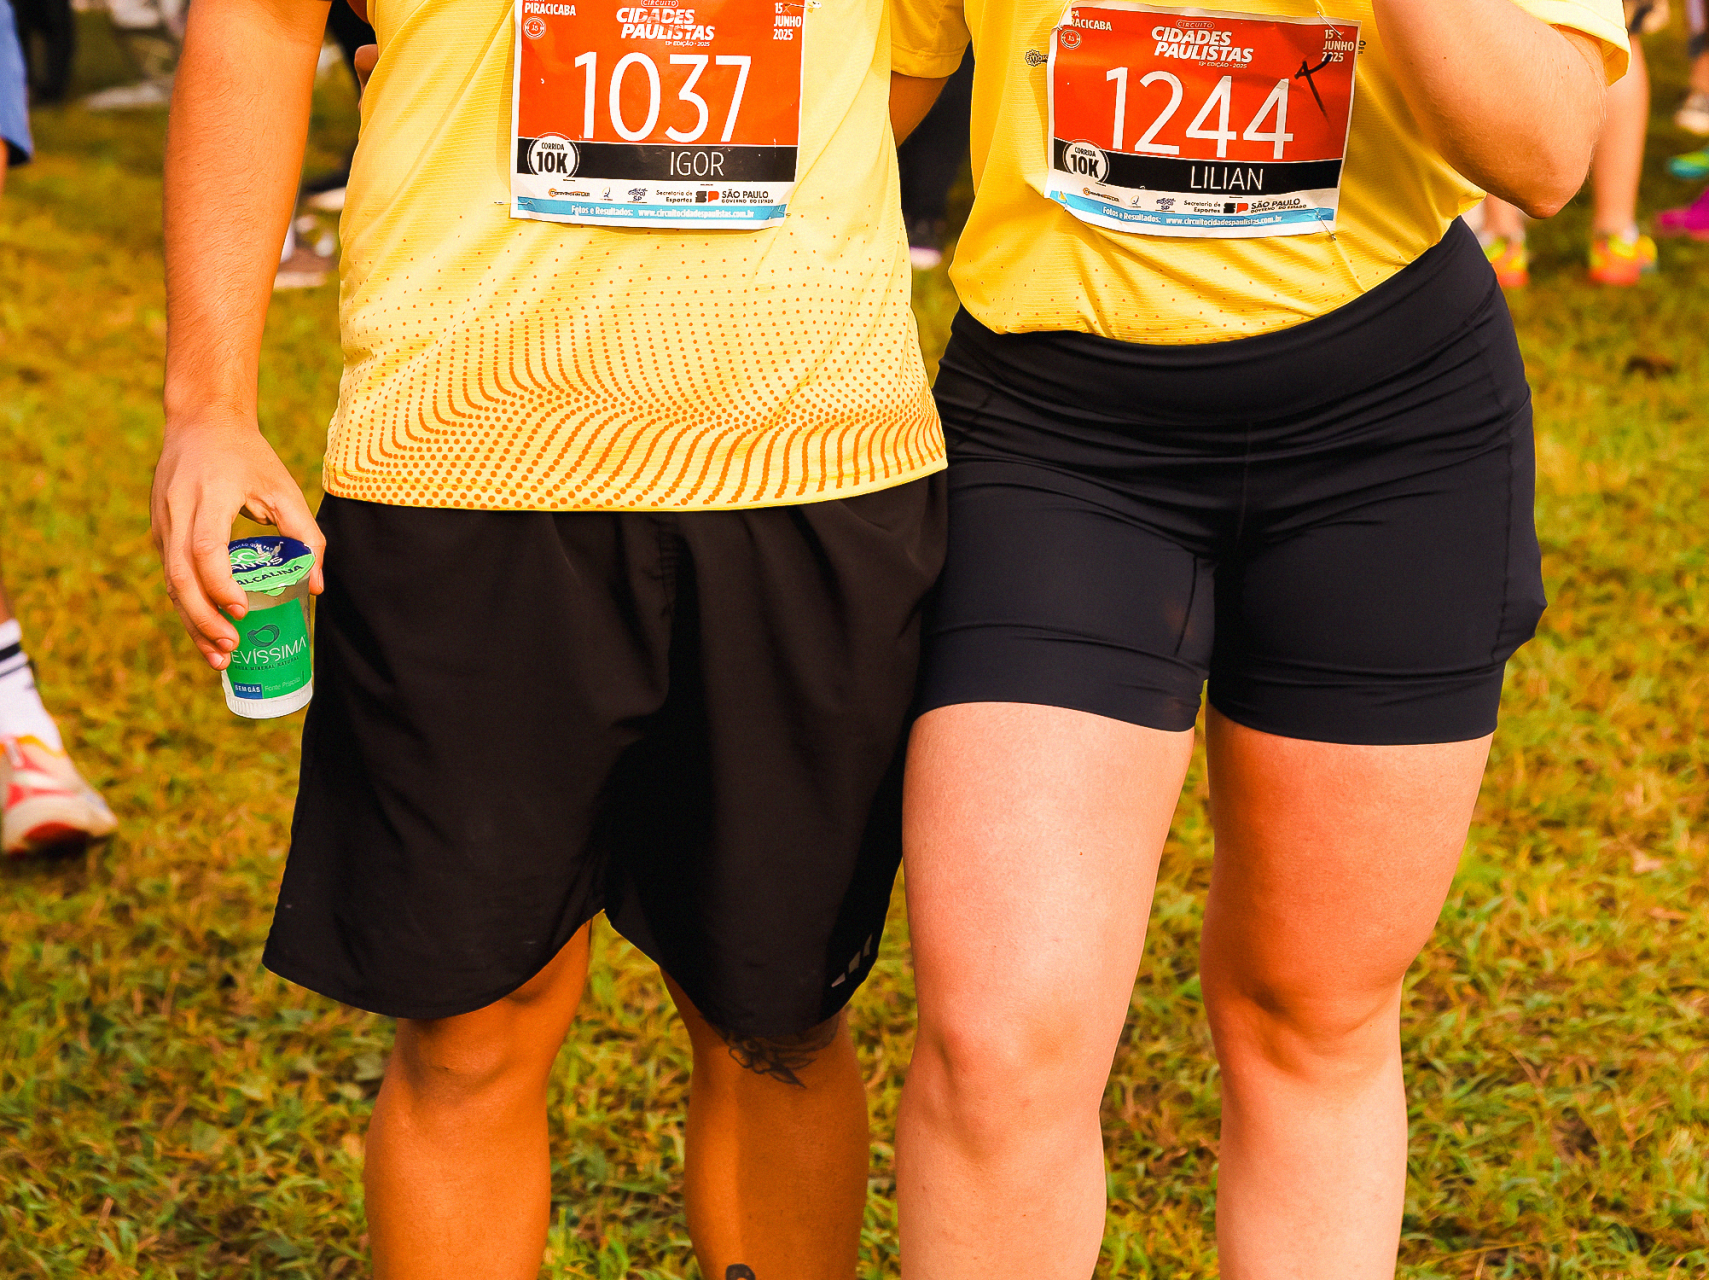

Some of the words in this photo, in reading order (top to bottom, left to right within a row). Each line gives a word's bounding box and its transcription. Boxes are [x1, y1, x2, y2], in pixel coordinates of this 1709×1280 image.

[524, 2, 576, 16] PIRACICABA
[642, 0, 677, 7] CIRCUITO
[775, 2, 784, 14] 15
[616, 7, 695, 25] CIDADES
[774, 15, 802, 27] JUNHO
[1071, 18, 1113, 31] RACICABA
[1176, 20, 1213, 29] CIRCUITO
[621, 23, 716, 41] PAULISTAS
[773, 28, 793, 40] 2025
[1151, 25, 1233, 47] CIDADES
[1324, 29, 1334, 39] 15
[1154, 41, 1254, 63] PAULISTAS
[1323, 40, 1355, 52] JUNHO
[574, 51, 752, 143] 1037
[1105, 66, 1294, 160] 1244
[541, 142, 565, 150] CORRIDA
[536, 151, 568, 174] 10K
[669, 151, 725, 177] IGOR
[1070, 154, 1100, 179] 10K
[1190, 165, 1264, 191] LILIAN
[721, 188, 741, 199] SÃO
[742, 190, 769, 199] PAULO
[1251, 200, 1270, 210] SÃO
[1271, 198, 1301, 207] PAULO
[1103, 206, 1119, 217] Fotos
[1124, 212, 1161, 223] Resultados:
[236, 565, 304, 585] ALCALINA
[231, 635, 307, 665] EVÍSSIMA
